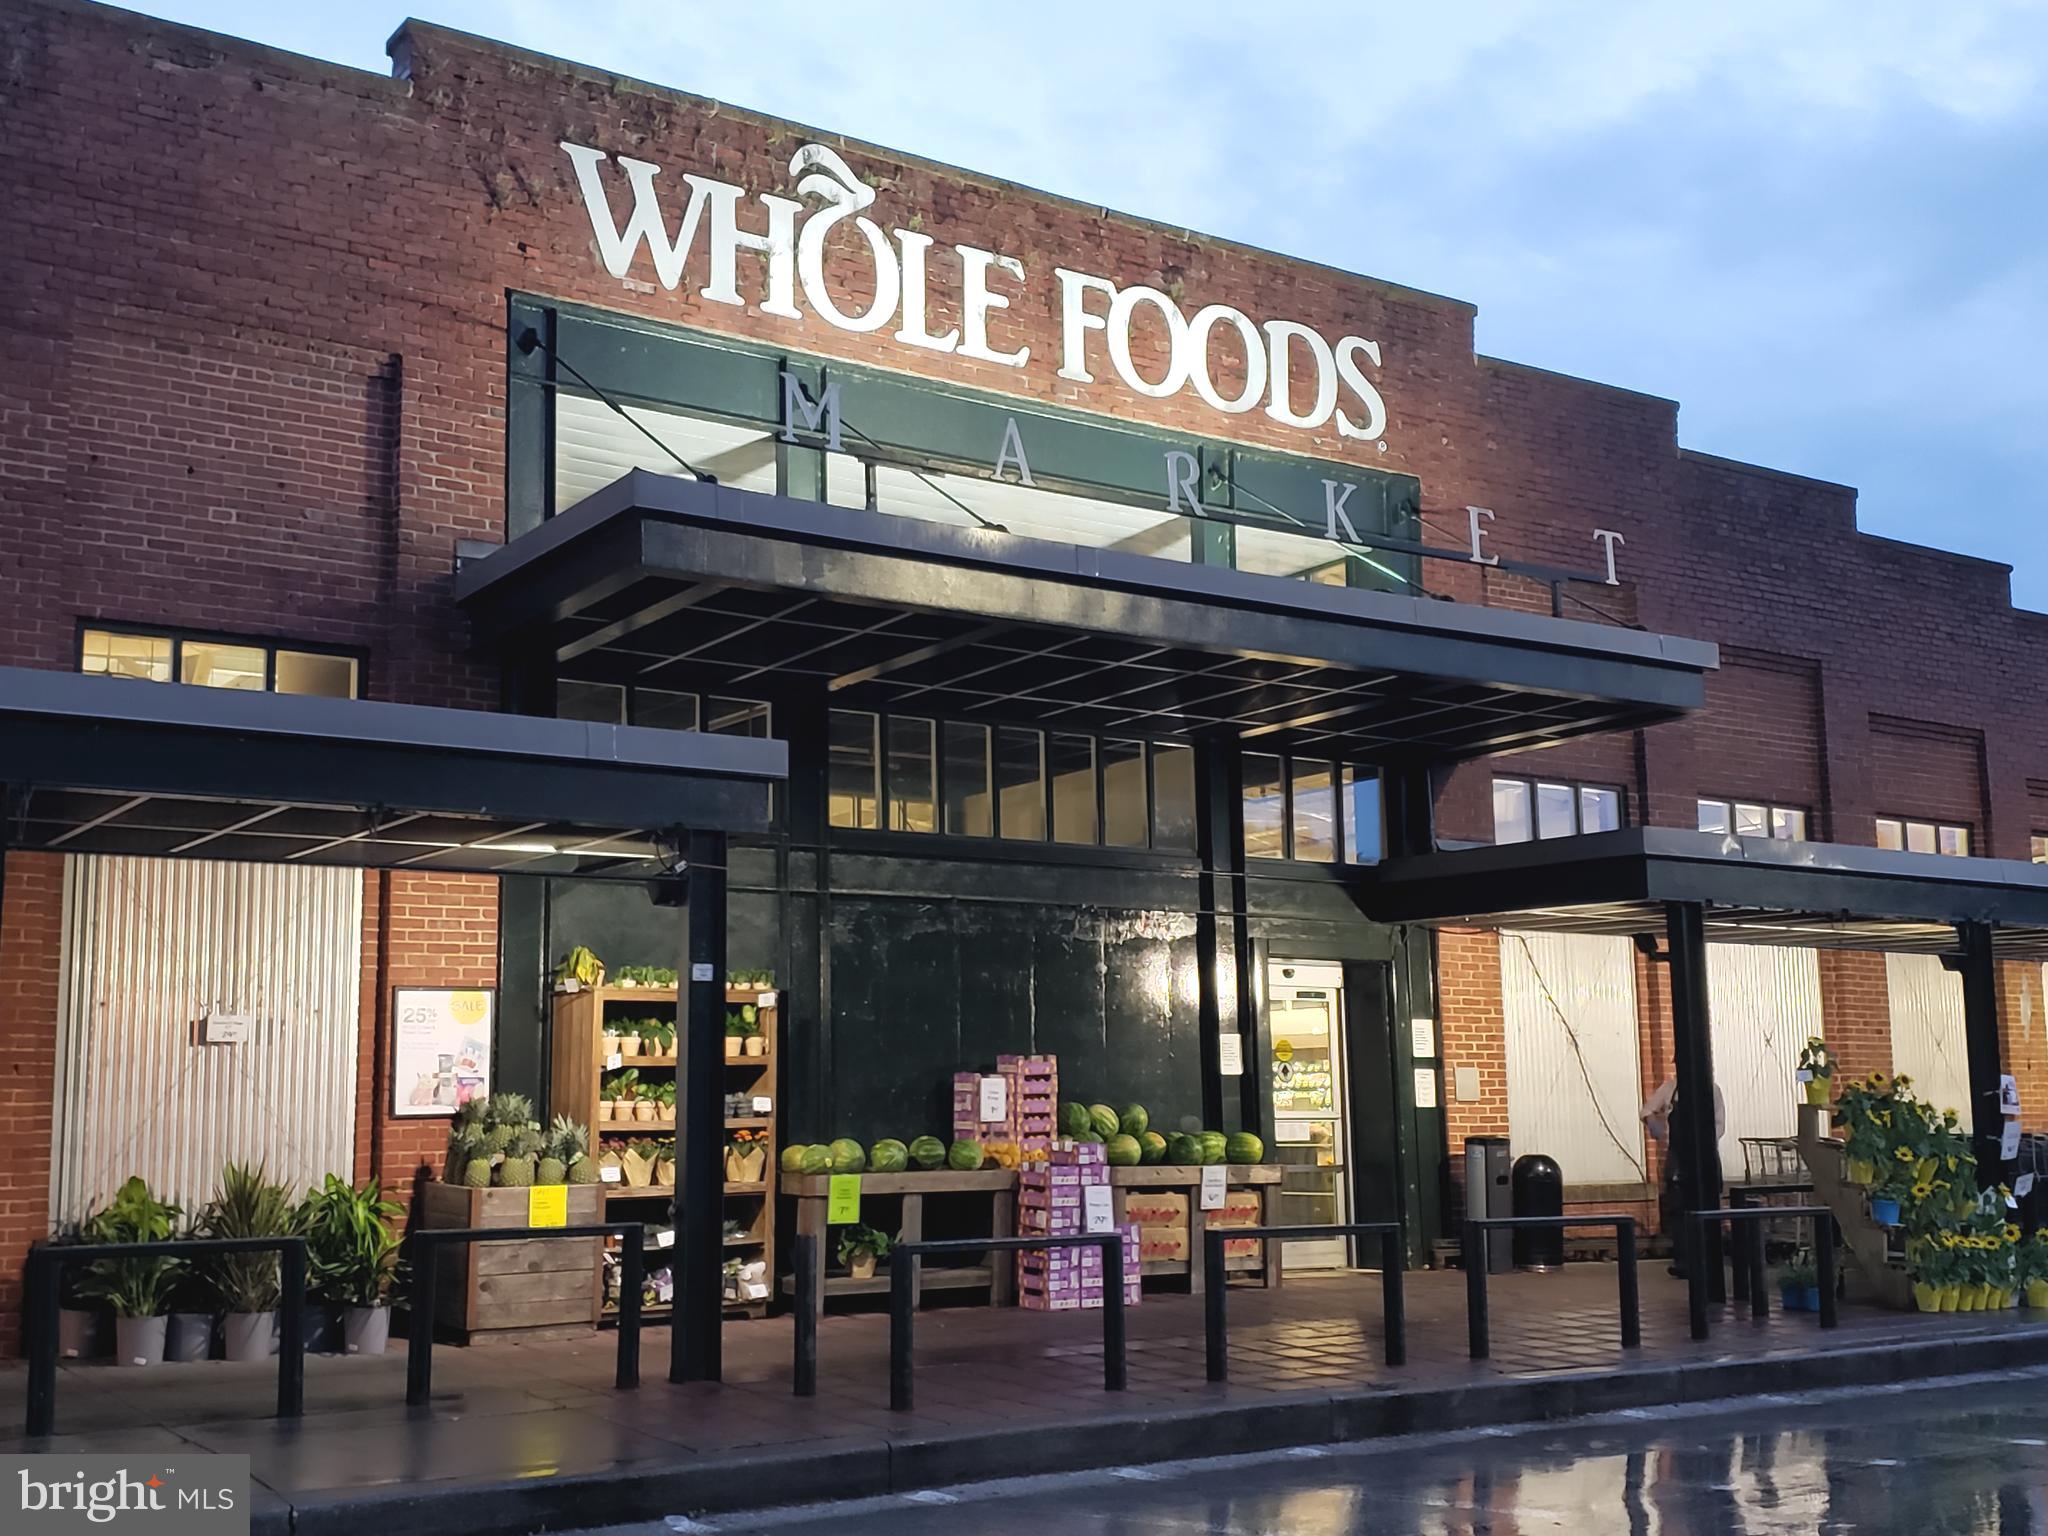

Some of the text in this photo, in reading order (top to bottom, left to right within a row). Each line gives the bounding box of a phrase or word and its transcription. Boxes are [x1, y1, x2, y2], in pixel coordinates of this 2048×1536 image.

[560, 142, 1387, 441] WHOLE FOODS
[775, 371, 1625, 586] MARKET
